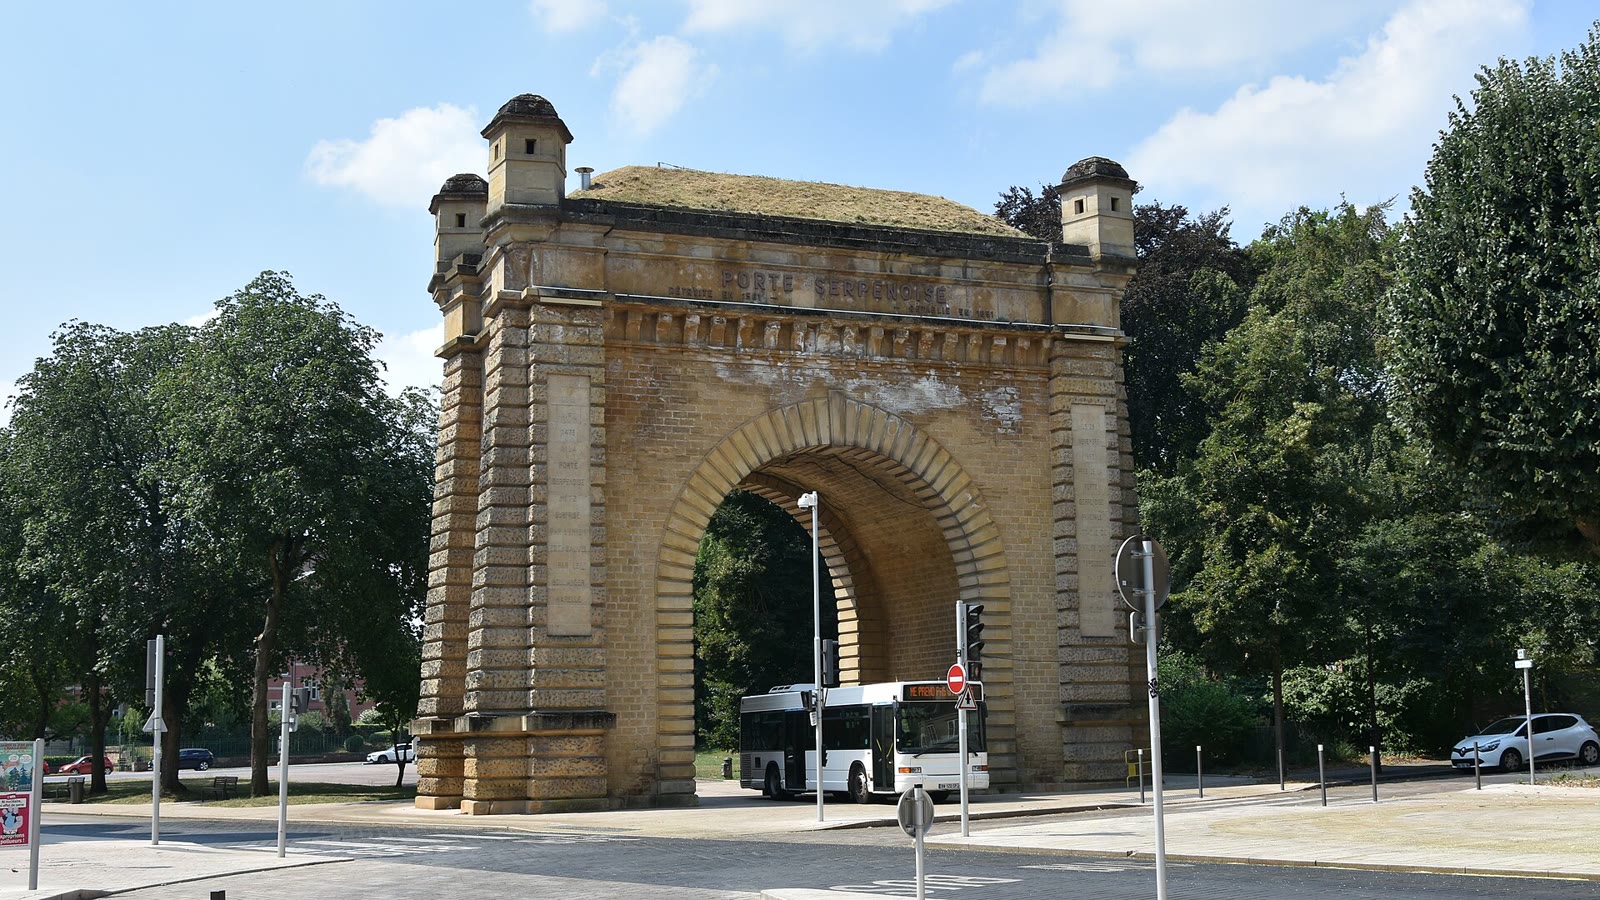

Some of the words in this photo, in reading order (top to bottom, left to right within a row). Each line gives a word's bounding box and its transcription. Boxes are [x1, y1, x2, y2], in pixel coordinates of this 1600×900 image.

[722, 270, 793, 292] PORTE
[814, 277, 947, 303] SERPENOISE
[558, 461, 579, 469] PORTE
[829, 874, 1023, 895] BUS
